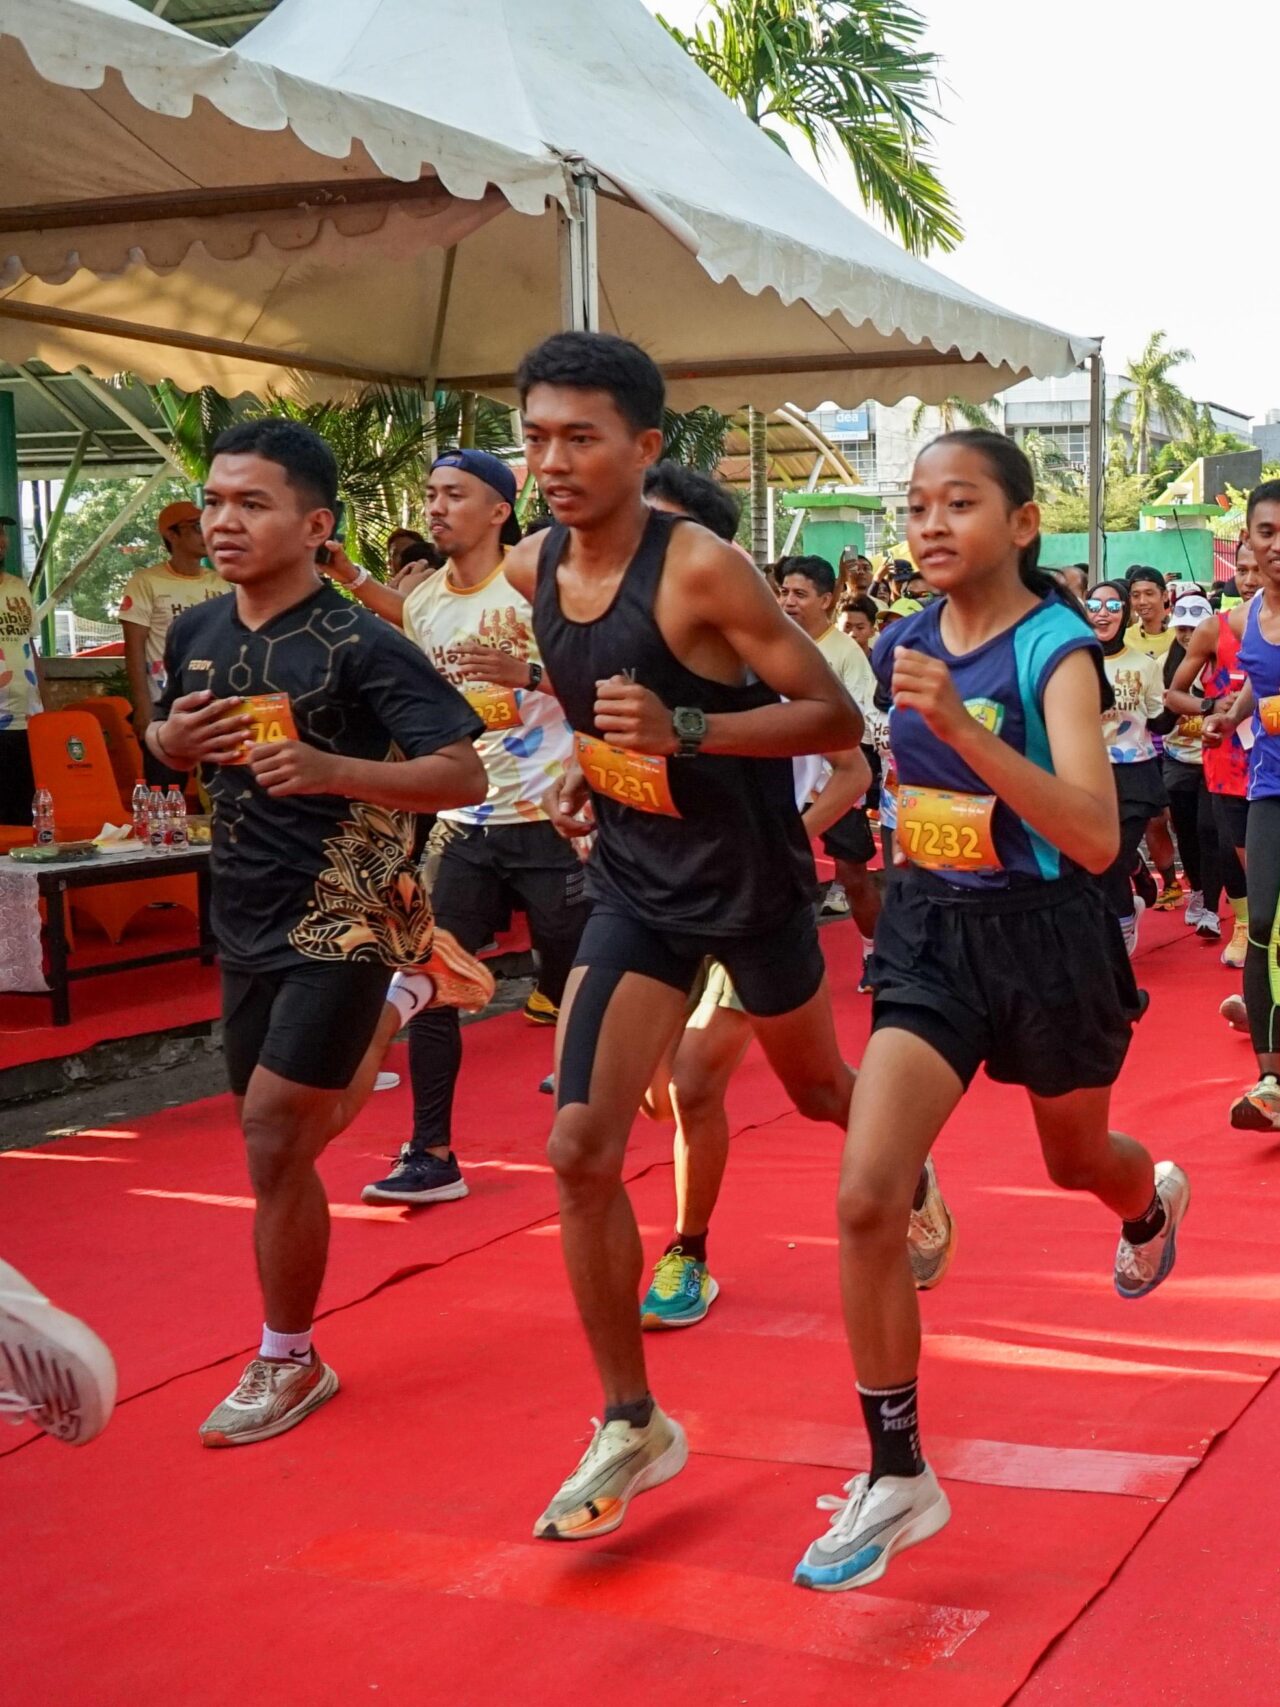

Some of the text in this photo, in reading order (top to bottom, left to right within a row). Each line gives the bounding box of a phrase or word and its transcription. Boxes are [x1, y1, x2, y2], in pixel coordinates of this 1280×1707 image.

[477, 702, 511, 722] 23
[250, 721, 288, 744] 74
[875, 739, 890, 751] Fu
[590, 765, 660, 807] 7231
[904, 820, 983, 859] 7232
